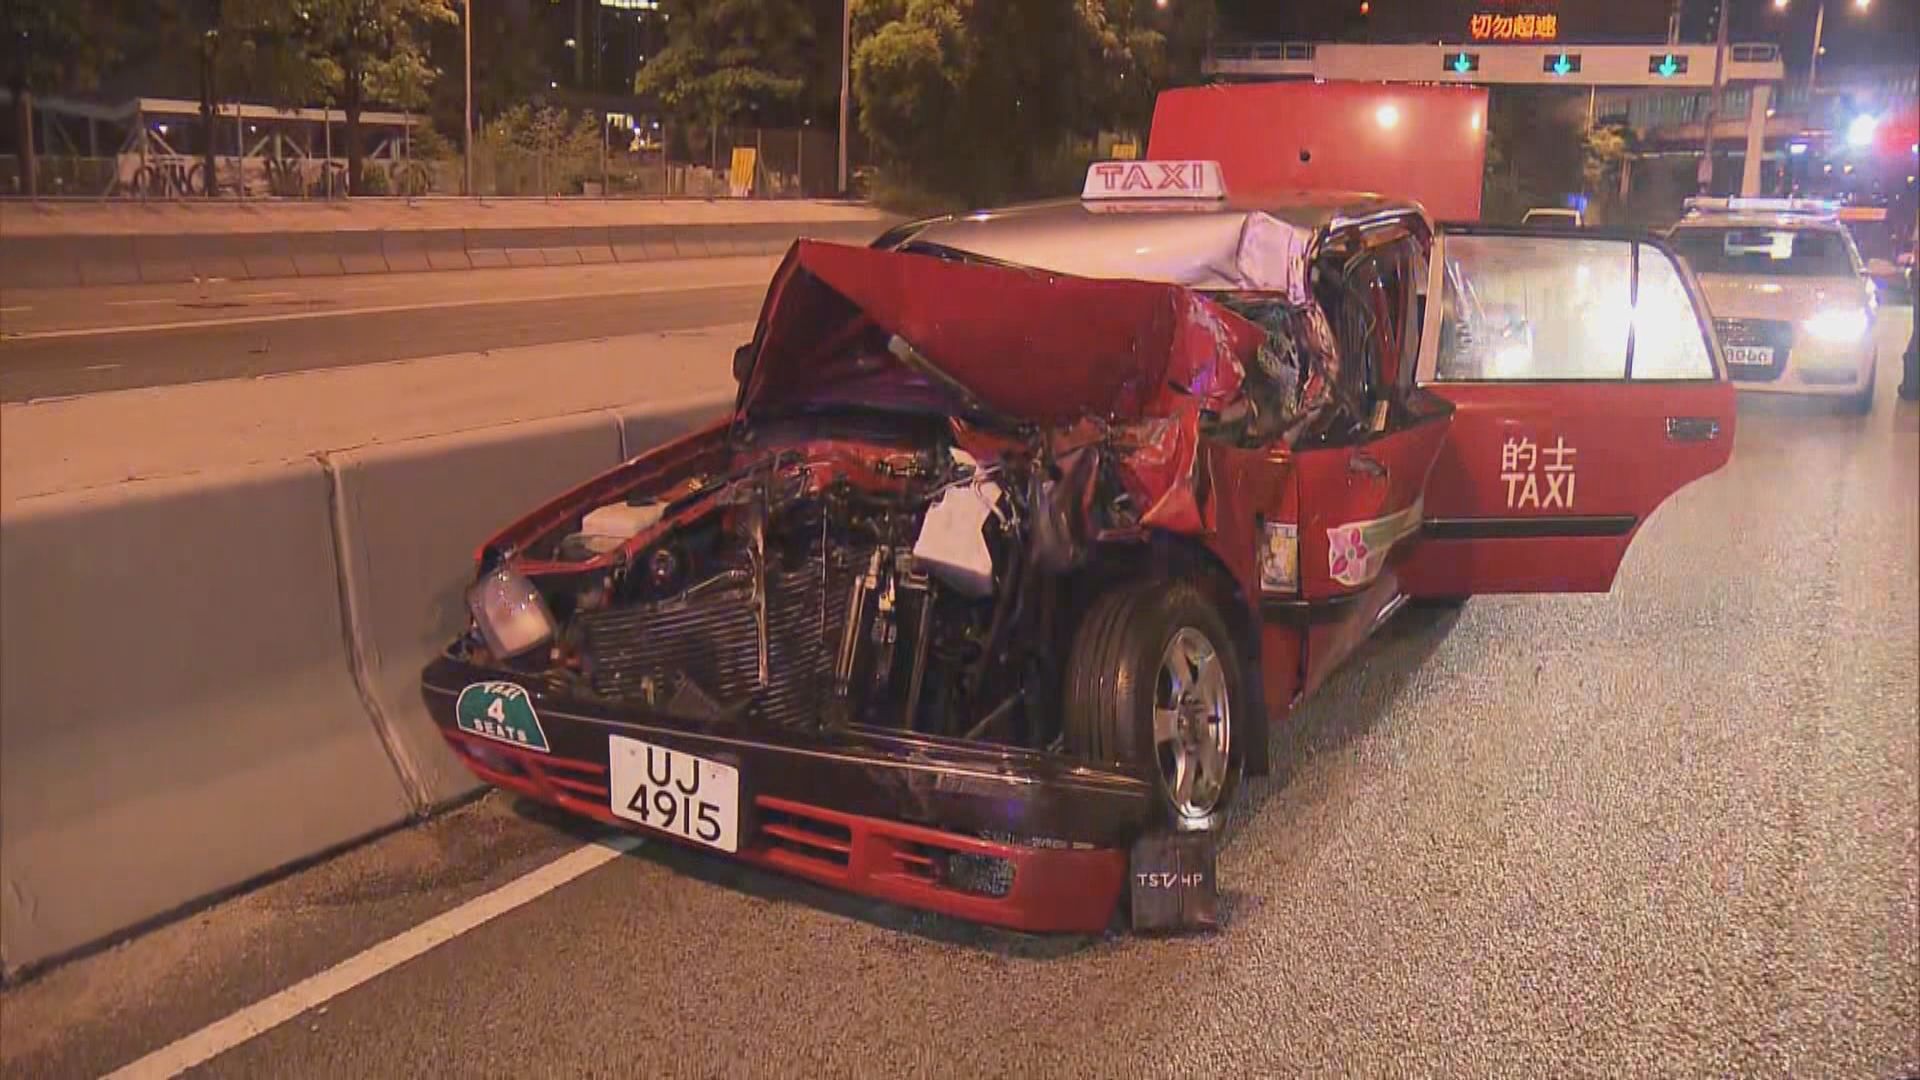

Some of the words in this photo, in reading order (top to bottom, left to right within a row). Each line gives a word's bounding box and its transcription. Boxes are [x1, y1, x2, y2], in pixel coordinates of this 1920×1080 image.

[1471, 13, 1557, 39] 切勿超速
[1096, 164, 1203, 189] TAXI
[1502, 436, 1577, 471] 的士
[1501, 473, 1575, 508] TAXI
[487, 698, 506, 721] 4
[647, 747, 700, 796] UJ
[627, 784, 722, 842] 4915
